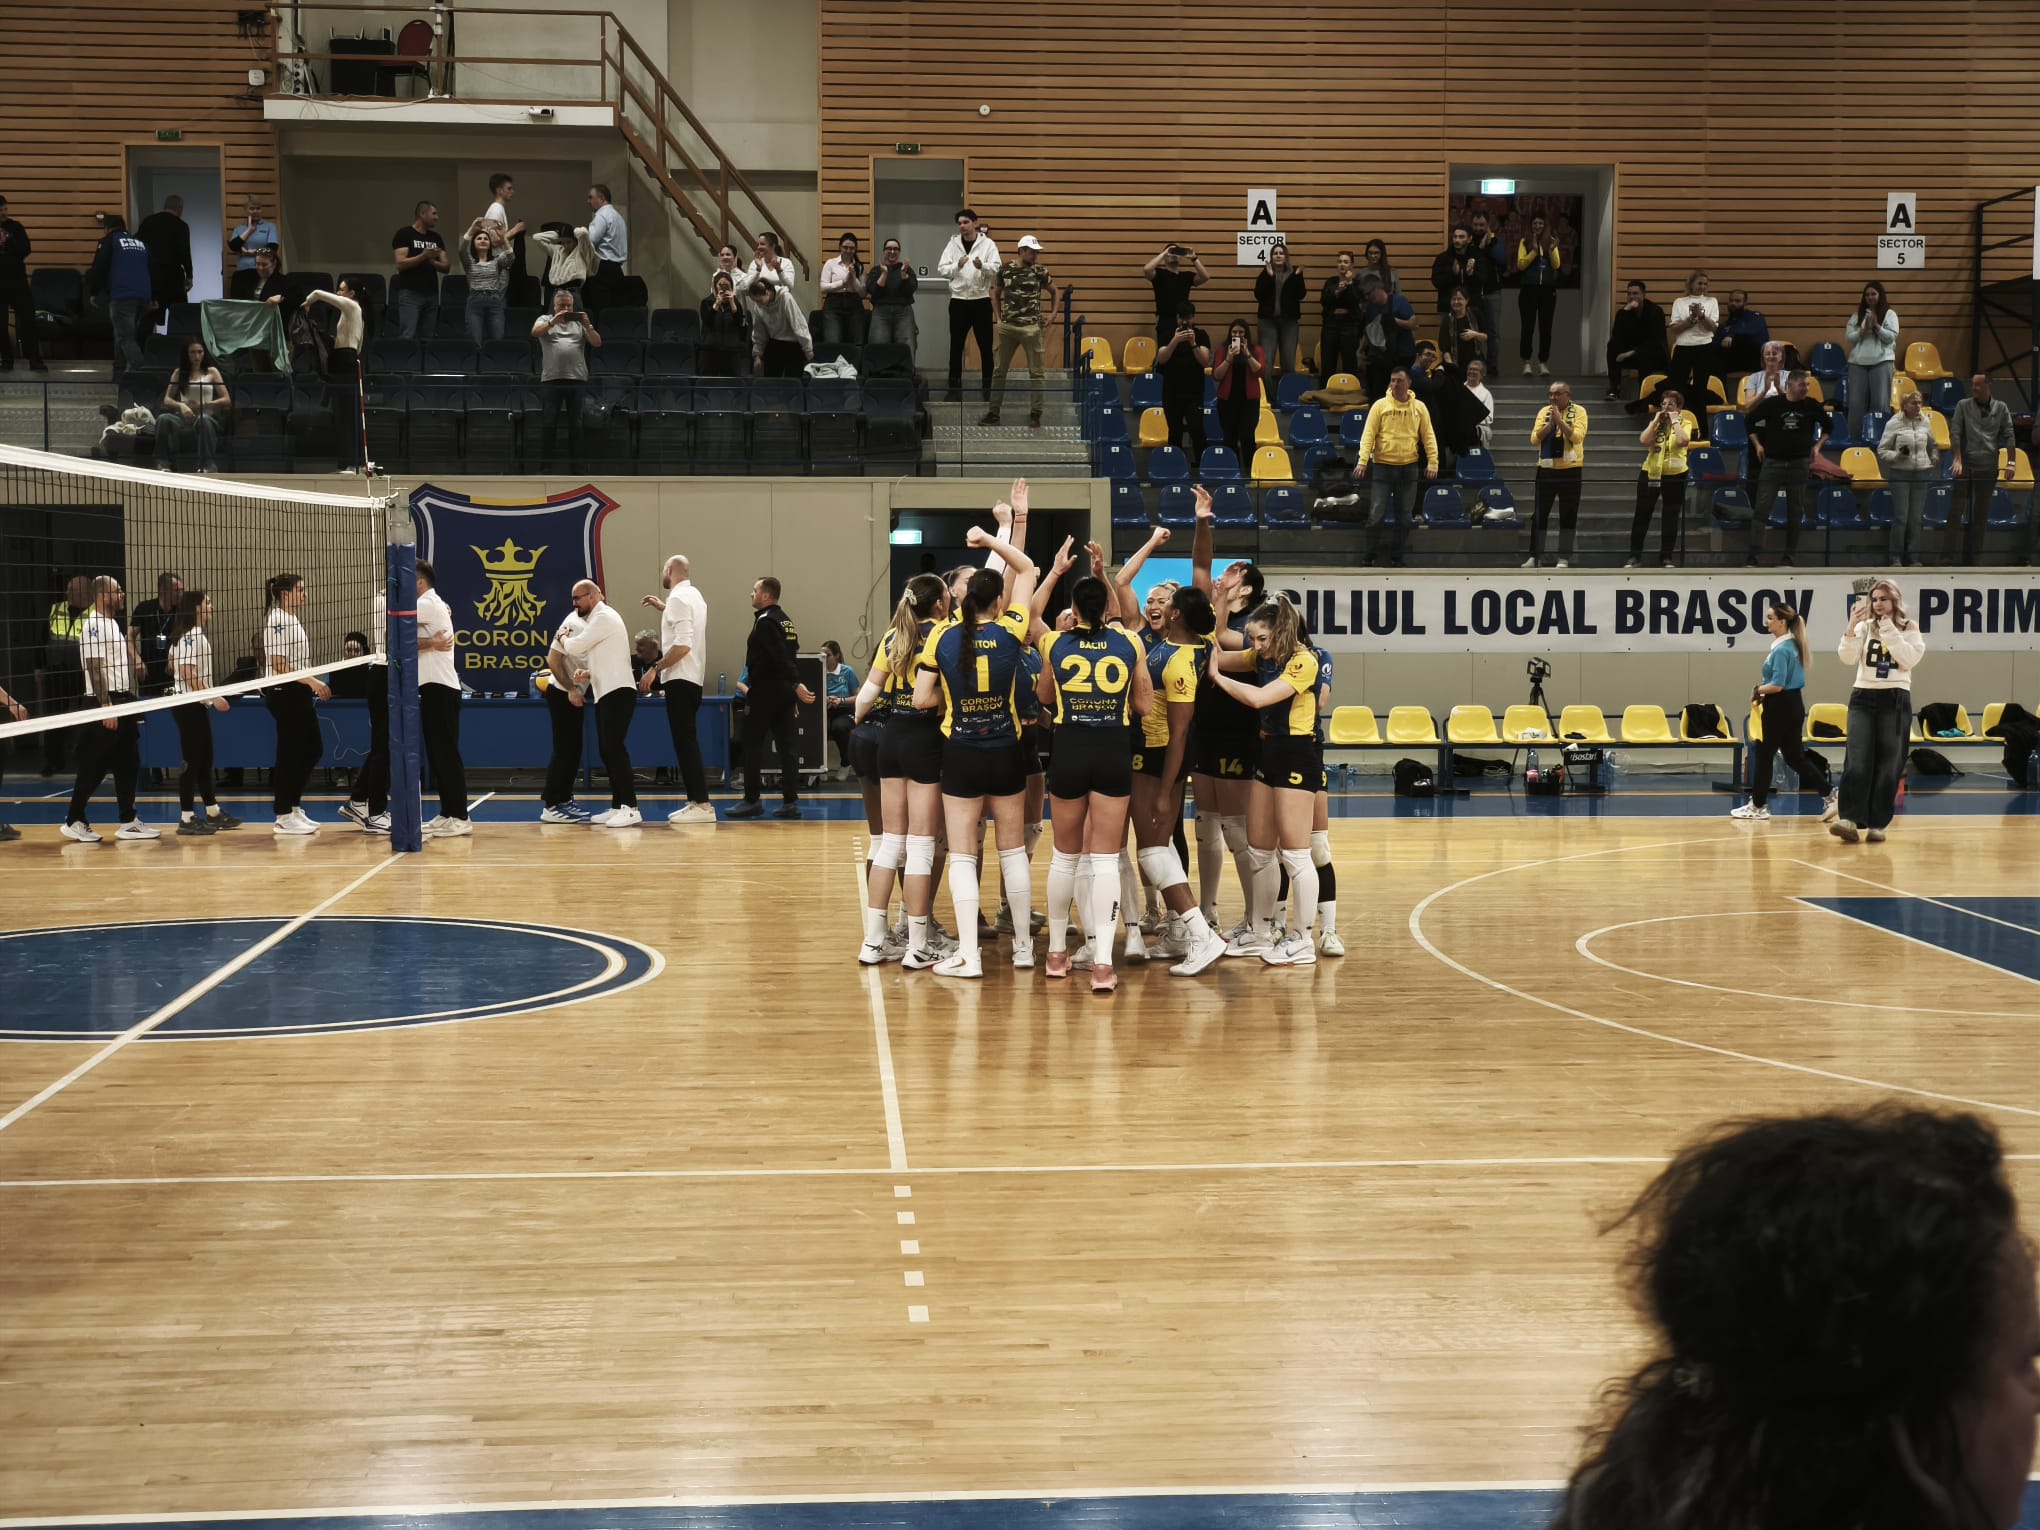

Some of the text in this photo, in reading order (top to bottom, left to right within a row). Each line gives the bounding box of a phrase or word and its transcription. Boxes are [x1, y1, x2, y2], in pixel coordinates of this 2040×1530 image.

[1250, 199, 1274, 225] A
[1889, 202, 1912, 228] A
[1239, 235, 1284, 246] SECTOR
[1879, 238, 1924, 249] SECTOR
[1257, 249, 1267, 262] 4
[1896, 252, 1906, 265] 5
[1282, 588, 1814, 649] ILIUL LOCAL BRAȘOV
[454, 630, 548, 647] CORON
[1079, 640, 1108, 650] BACIU
[976, 654, 990, 693] 1
[1060, 654, 1129, 694] 20
[960, 695, 1003, 706] CORONA
[1219, 757, 1244, 776] 14
